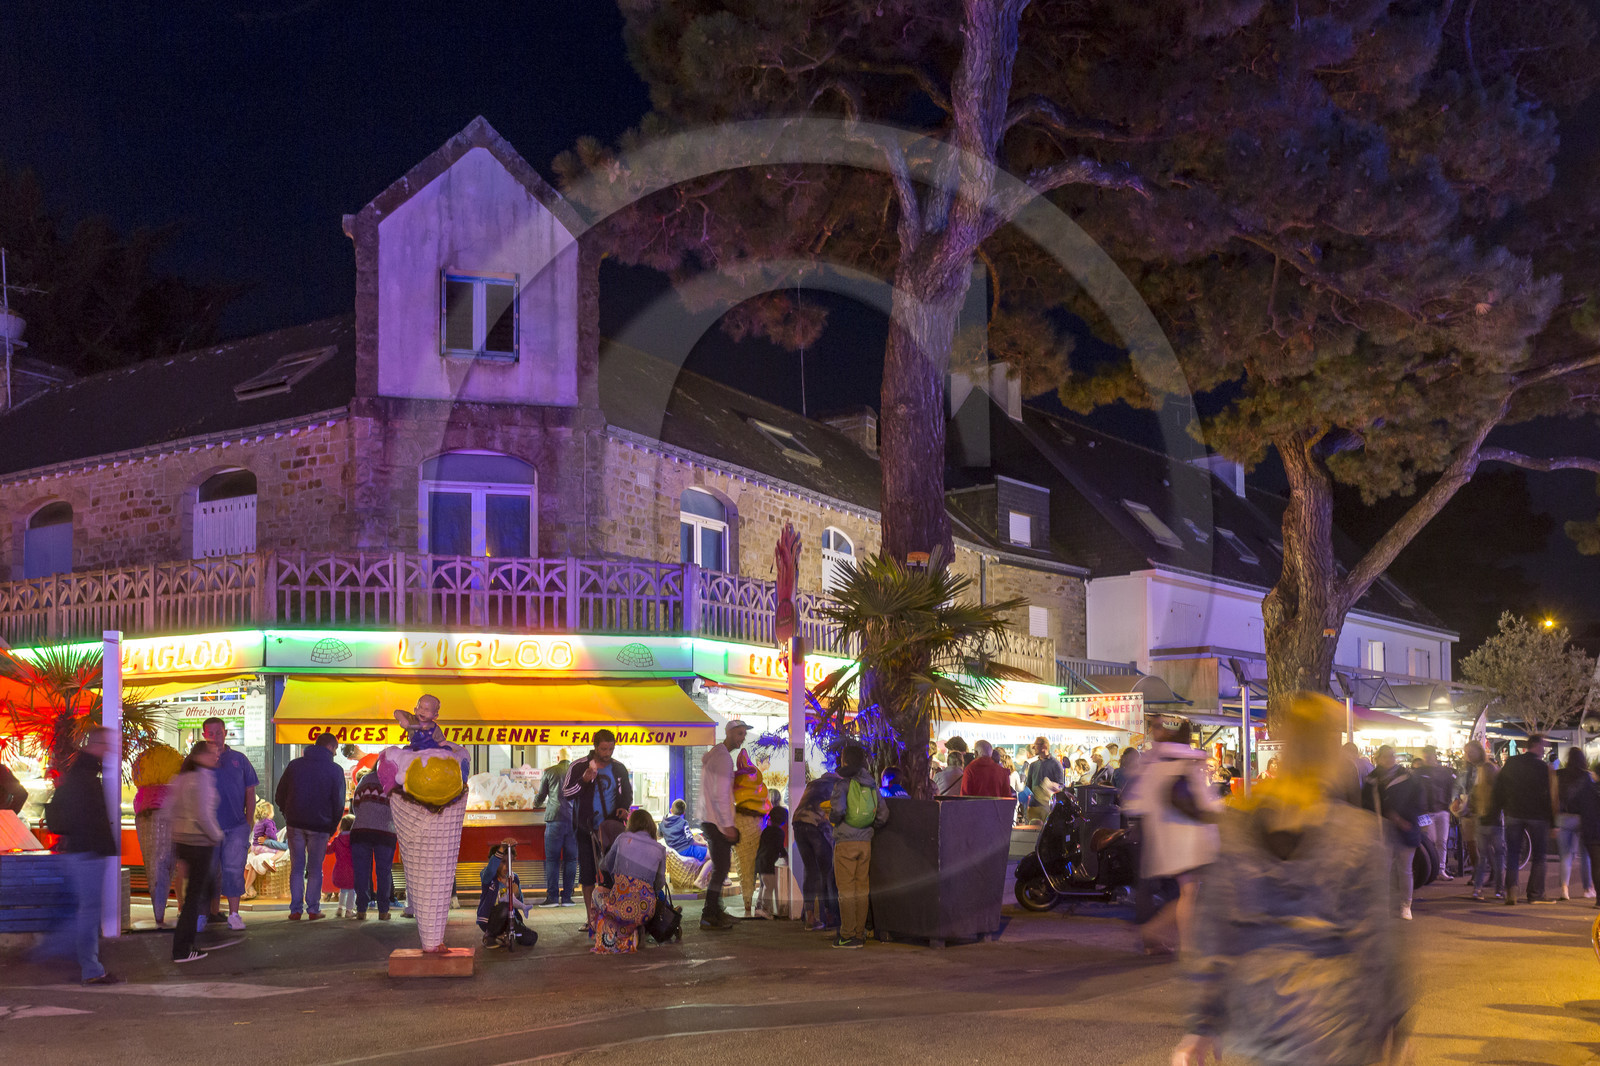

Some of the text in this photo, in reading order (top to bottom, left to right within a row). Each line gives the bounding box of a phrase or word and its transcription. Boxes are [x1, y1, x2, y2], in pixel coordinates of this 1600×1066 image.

[397, 638, 573, 668] L'IGLOO
[186, 706, 226, 717] Offrez-Vous
[1105, 704, 1142, 714] SWEETY
